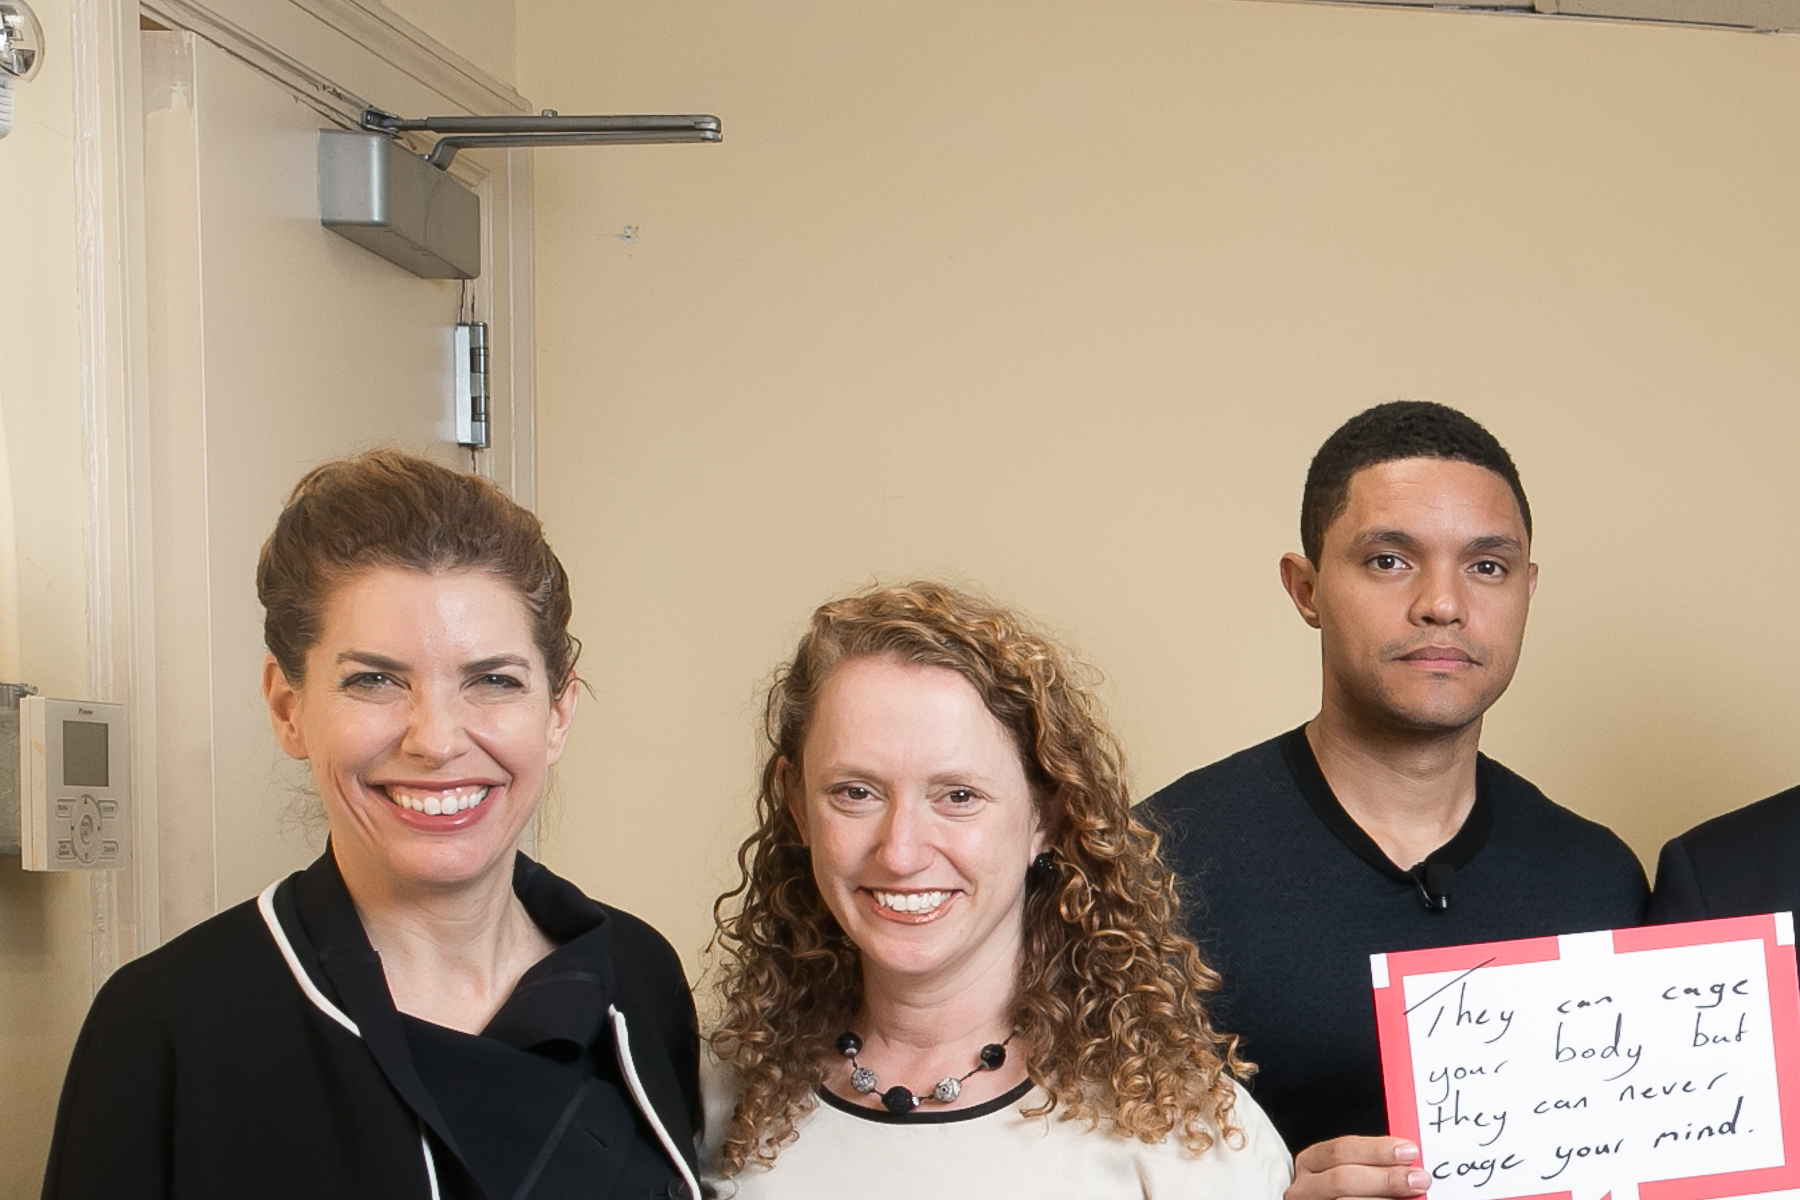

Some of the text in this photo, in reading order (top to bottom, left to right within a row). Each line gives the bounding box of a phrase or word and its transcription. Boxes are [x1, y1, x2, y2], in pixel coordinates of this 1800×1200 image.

[1404, 957, 1750, 1044] They can cage
[1427, 1011, 1748, 1106] your body but
[1429, 1072, 1728, 1147] they can never
[1431, 1095, 1754, 1188] cage your mind.
